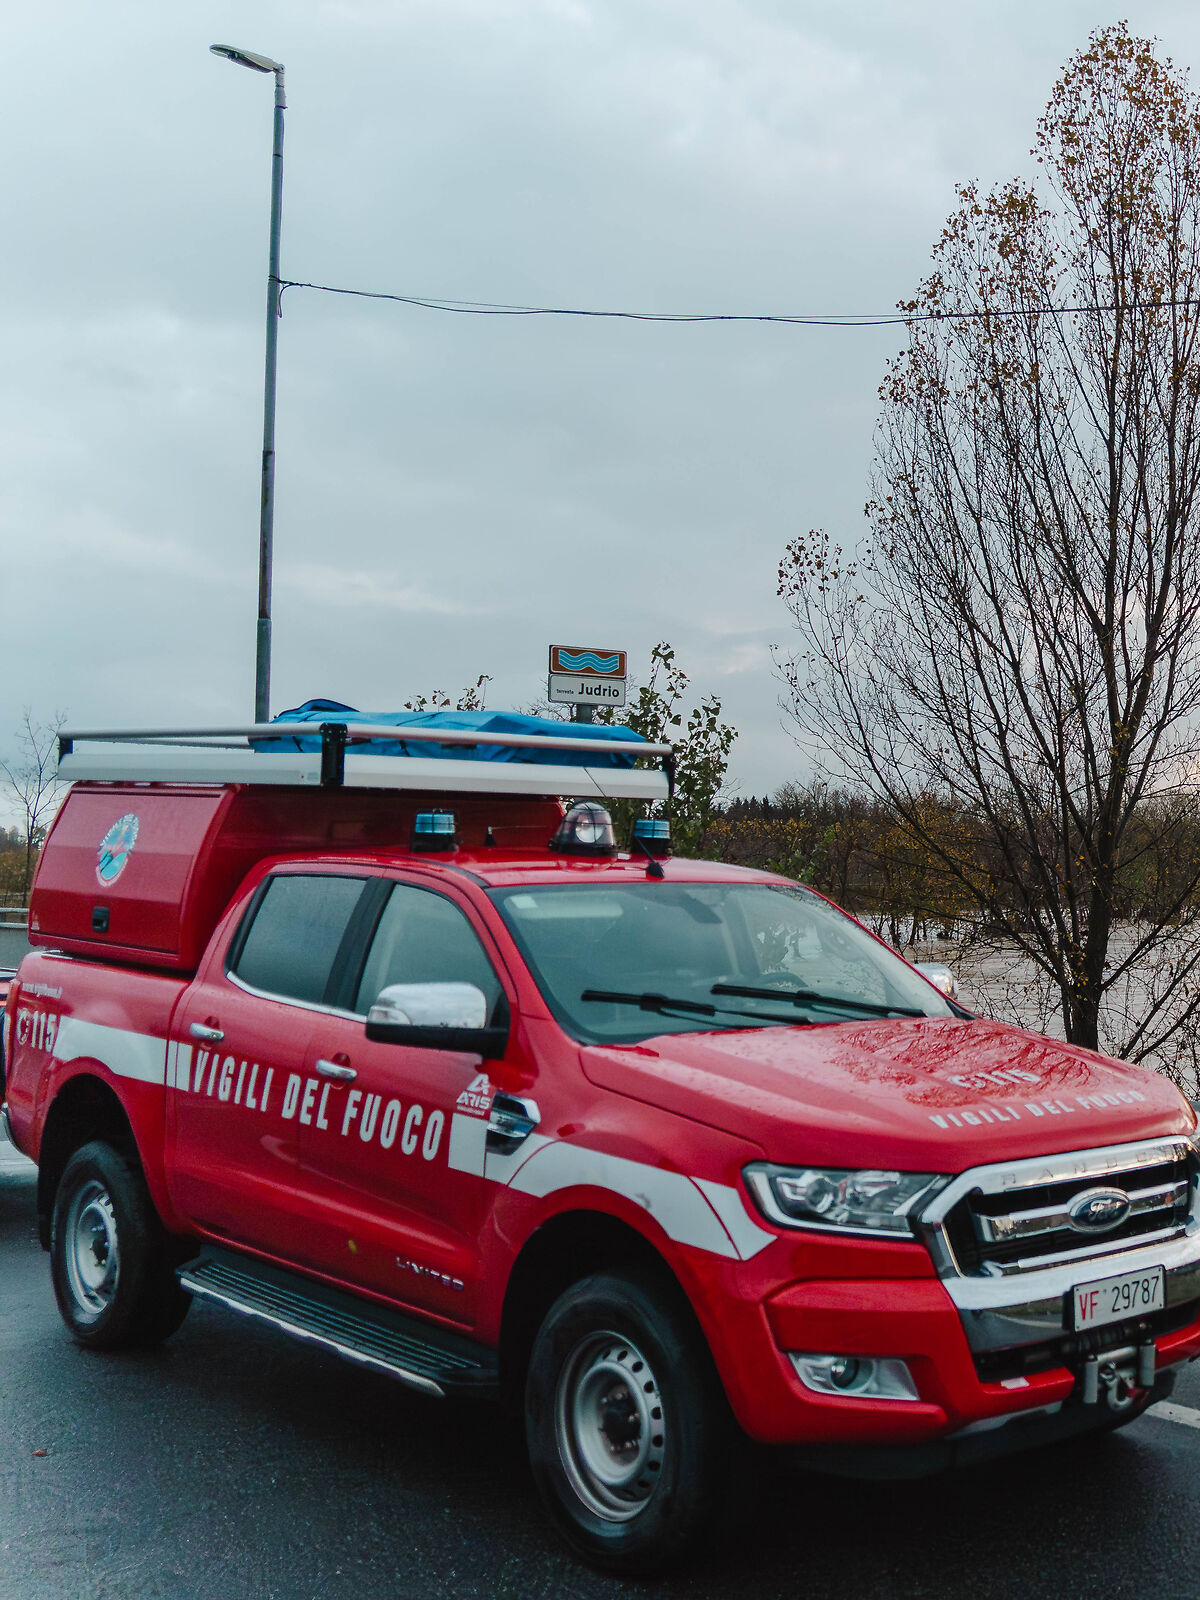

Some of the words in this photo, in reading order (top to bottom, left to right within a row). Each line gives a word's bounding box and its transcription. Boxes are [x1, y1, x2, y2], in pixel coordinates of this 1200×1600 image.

[578, 683, 619, 698] Judrio
[31, 1010, 57, 1052] 115
[979, 1068, 1041, 1085] 115
[193, 1049, 275, 1113] VIGILI
[281, 1073, 331, 1130] DEL
[340, 1089, 446, 1162] FUOCO
[929, 1106, 1021, 1129] VIGILI
[1024, 1100, 1076, 1118] DEL
[1075, 1089, 1147, 1110] FUOCO
[1079, 1290, 1100, 1321] VF
[1111, 1275, 1160, 1313] 29787
